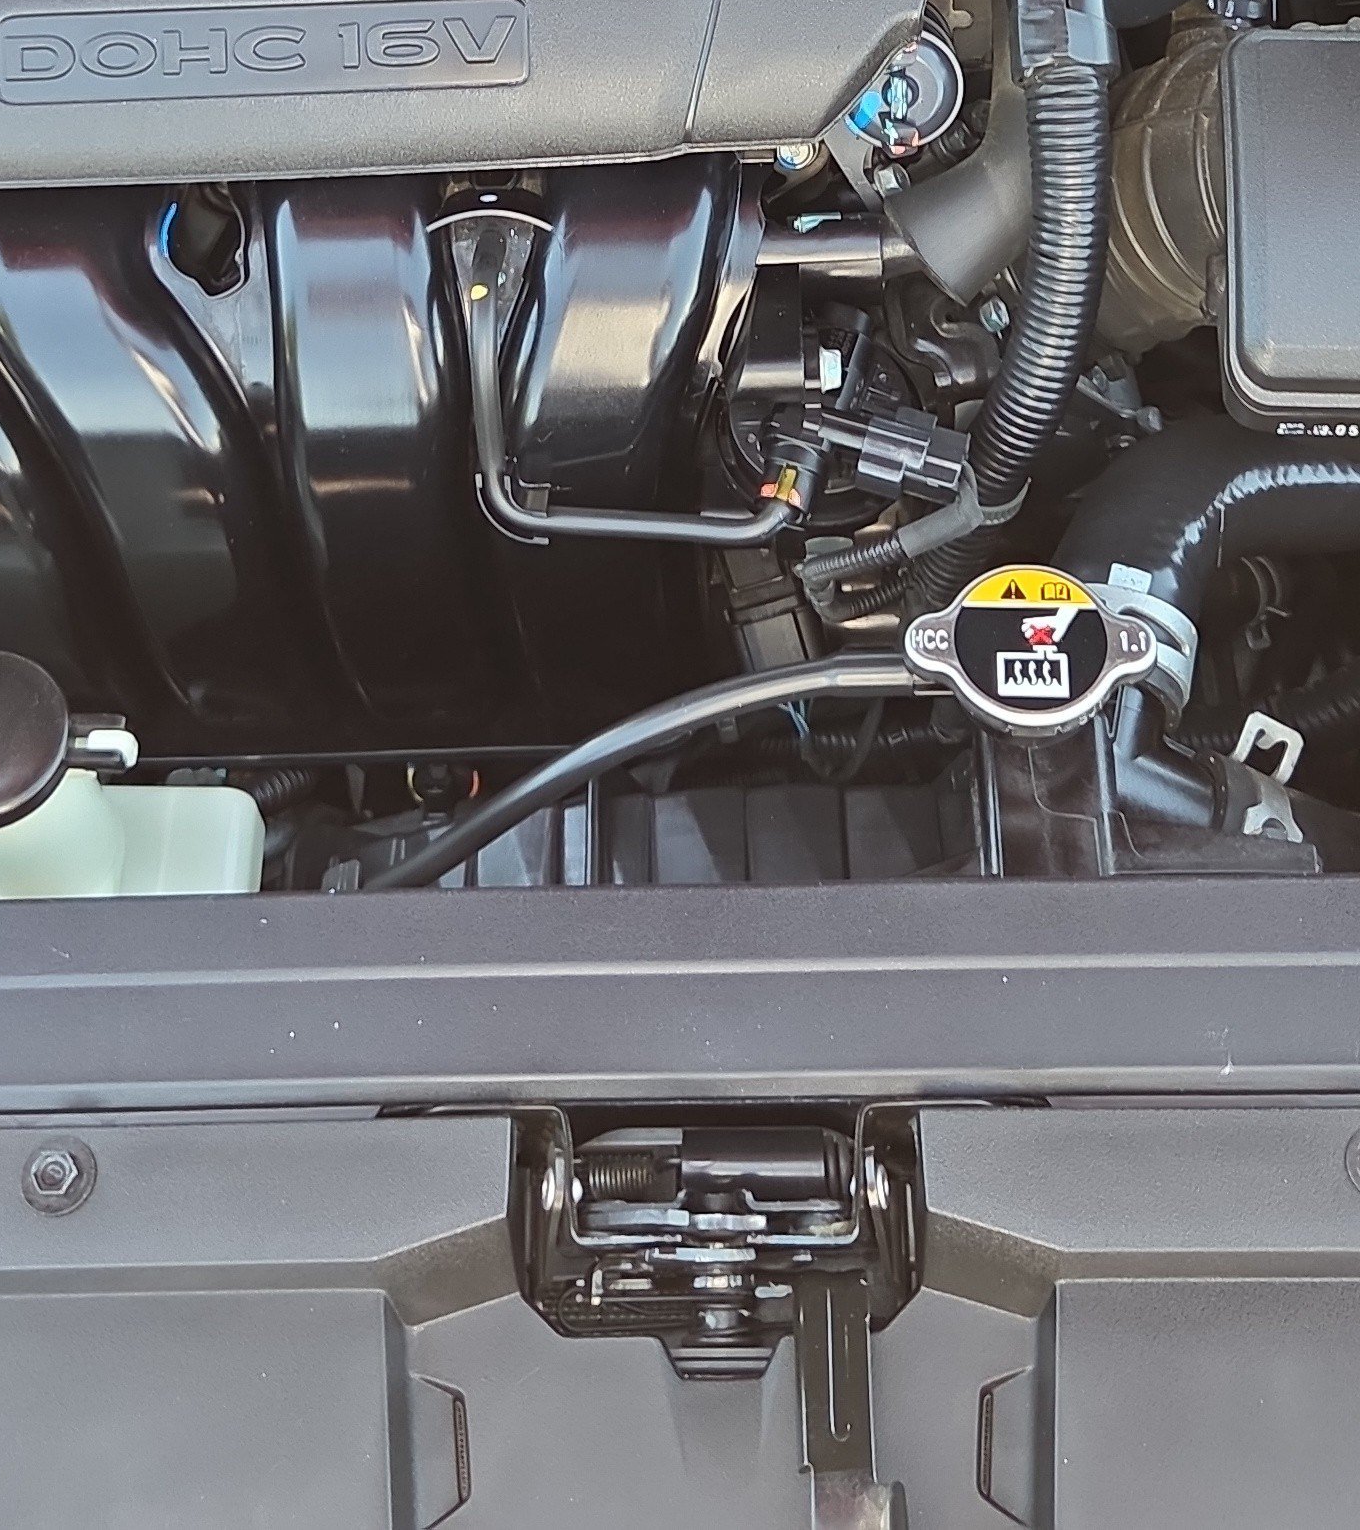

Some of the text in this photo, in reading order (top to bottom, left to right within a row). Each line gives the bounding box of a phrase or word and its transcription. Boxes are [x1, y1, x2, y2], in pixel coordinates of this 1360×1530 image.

[4, 15, 518, 82] DOHC 16V
[910, 628, 1147, 652] HCC 1.1
